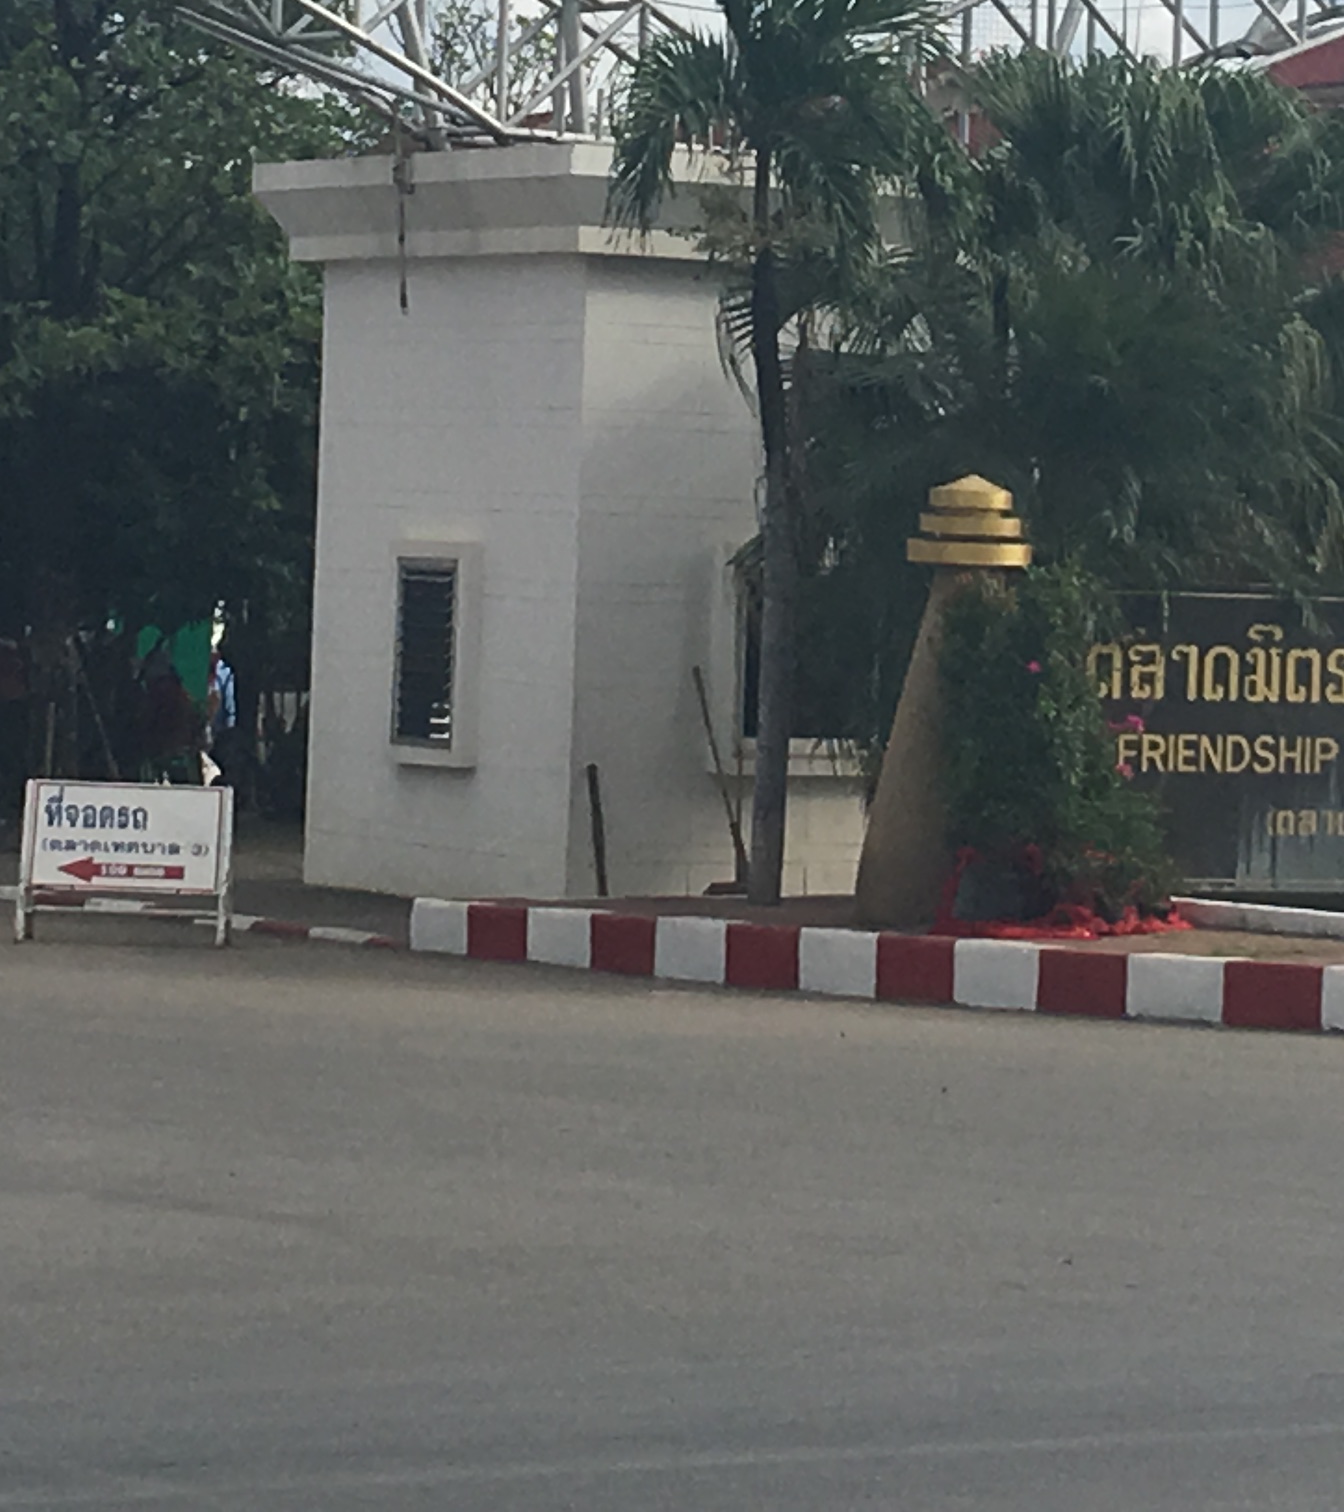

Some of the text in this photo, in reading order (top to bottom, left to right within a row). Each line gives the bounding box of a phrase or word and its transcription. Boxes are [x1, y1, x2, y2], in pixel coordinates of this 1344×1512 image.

[1116, 733, 1339, 776] FRIENDSHIP
[44, 786, 149, 831] ที่จอดรถ
